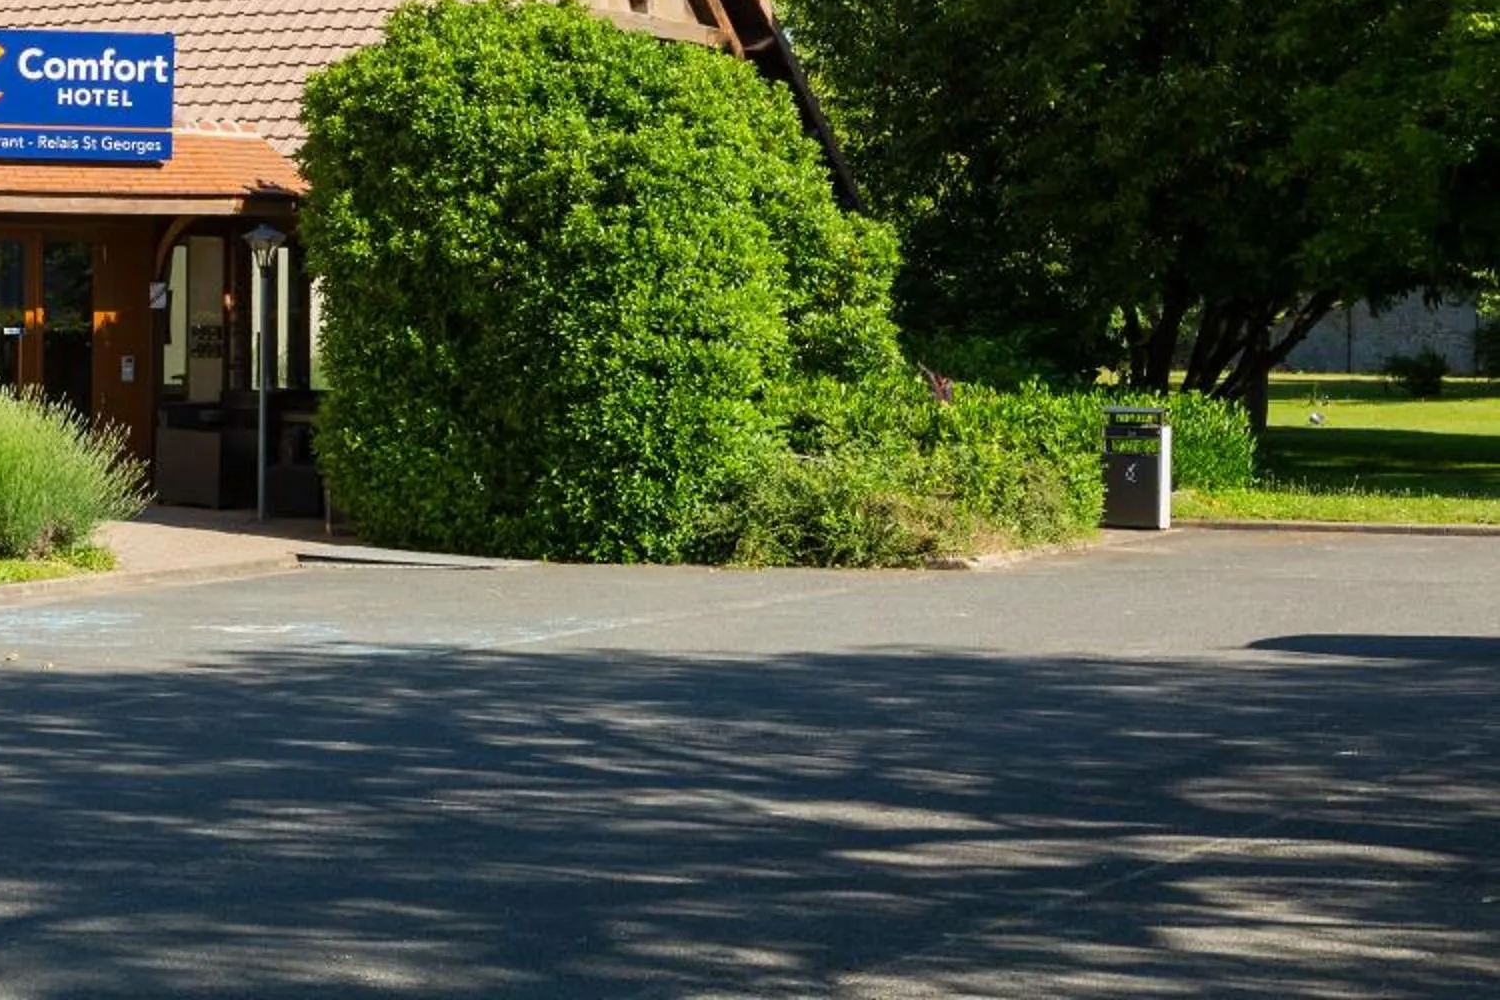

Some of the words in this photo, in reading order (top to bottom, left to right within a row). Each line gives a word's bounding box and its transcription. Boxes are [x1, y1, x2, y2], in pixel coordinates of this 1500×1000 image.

[18, 47, 169, 83] Comfort
[57, 87, 133, 107] HOTEL
[37, 135, 79, 150] Relais
[82, 136, 98, 151] St
[101, 136, 162, 155] Georges
